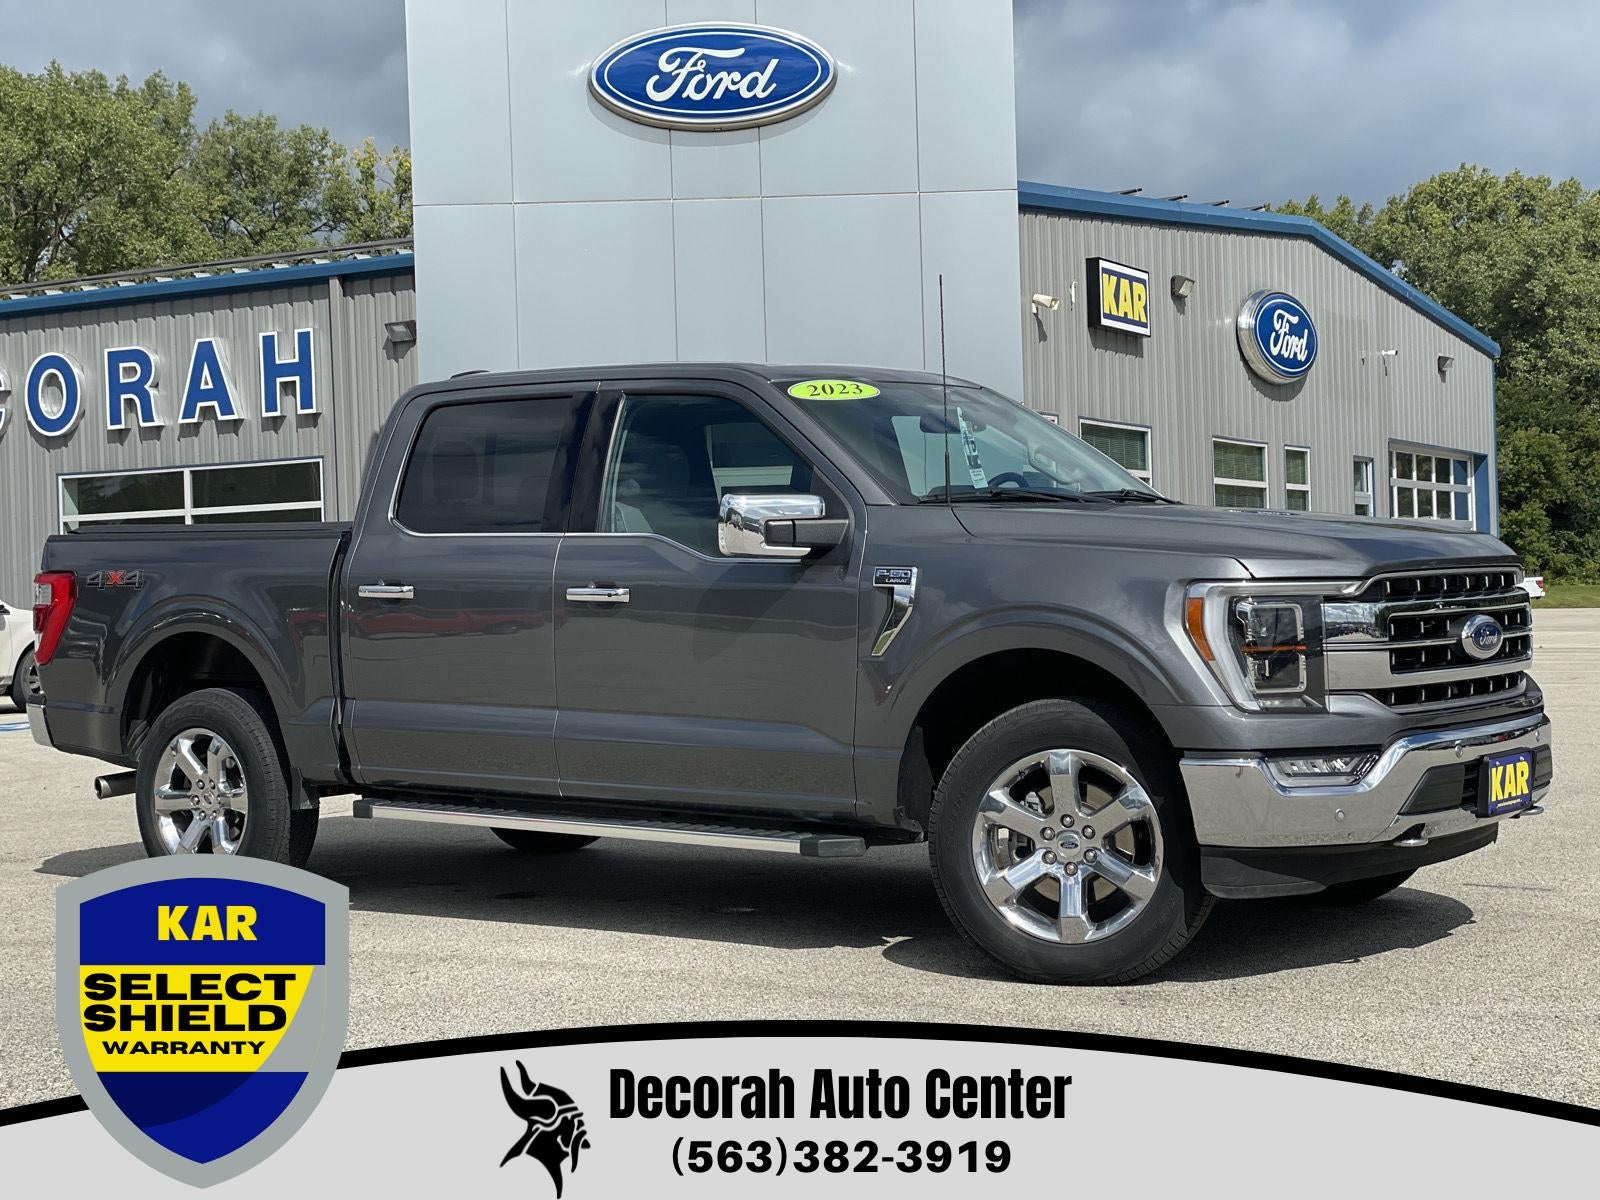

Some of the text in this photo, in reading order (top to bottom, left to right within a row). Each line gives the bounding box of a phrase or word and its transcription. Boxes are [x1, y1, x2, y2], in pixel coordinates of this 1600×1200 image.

[646, 47, 779, 102] Ford
[1102, 273, 1148, 323] KAR
[1270, 309, 1308, 362] Ford
[806, 383, 863, 397] 2023
[1480, 627, 1498, 645] Ford
[1491, 761, 1529, 802] KAR
